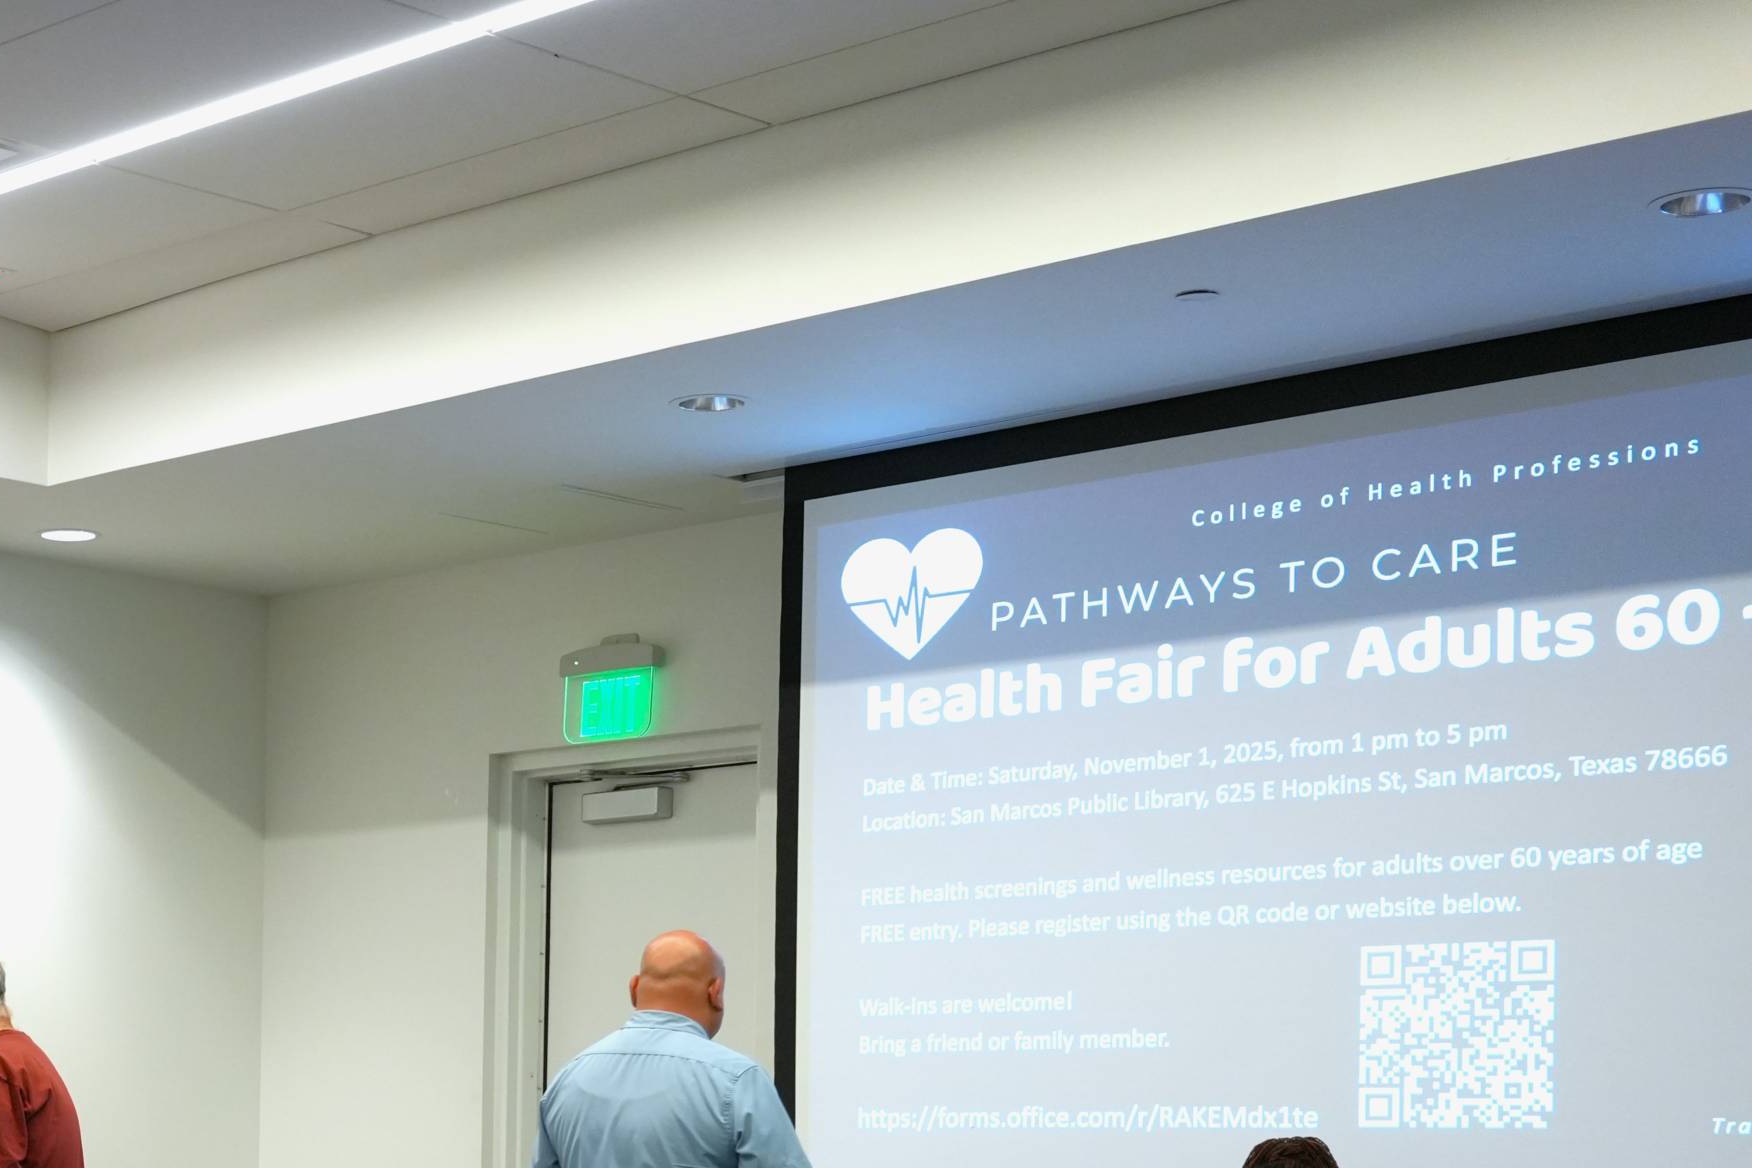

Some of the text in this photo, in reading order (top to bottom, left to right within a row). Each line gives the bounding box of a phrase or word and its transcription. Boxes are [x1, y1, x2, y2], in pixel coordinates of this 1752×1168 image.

[1191, 438, 1700, 528] College of Health Professions
[991, 531, 1518, 631] PATHWAYS TO CARE
[866, 588, 1720, 731] Health Fair for Adults 60
[580, 675, 640, 737] EXIT
[862, 744, 1729, 834] Location: San Marcos Public Library, 625 E Hopkins St, San Marcos, Texas 78666
[863, 724, 1507, 796] Date & Time: Saturday, November 1, 2025, from 1 pm to 5 pm
[860, 839, 1703, 906] FREE health screenings and wellness resources for adults over 60 years of age
[860, 891, 1521, 945] FREE entry. Please register using the QR code or website below.
[859, 991, 1073, 1017] Walk-ins are welcome!
[859, 1028, 1171, 1057] Bring a friend or family member.
[856, 1104, 1318, 1133] https://forms.office.com/r/RAKEMdx1te
